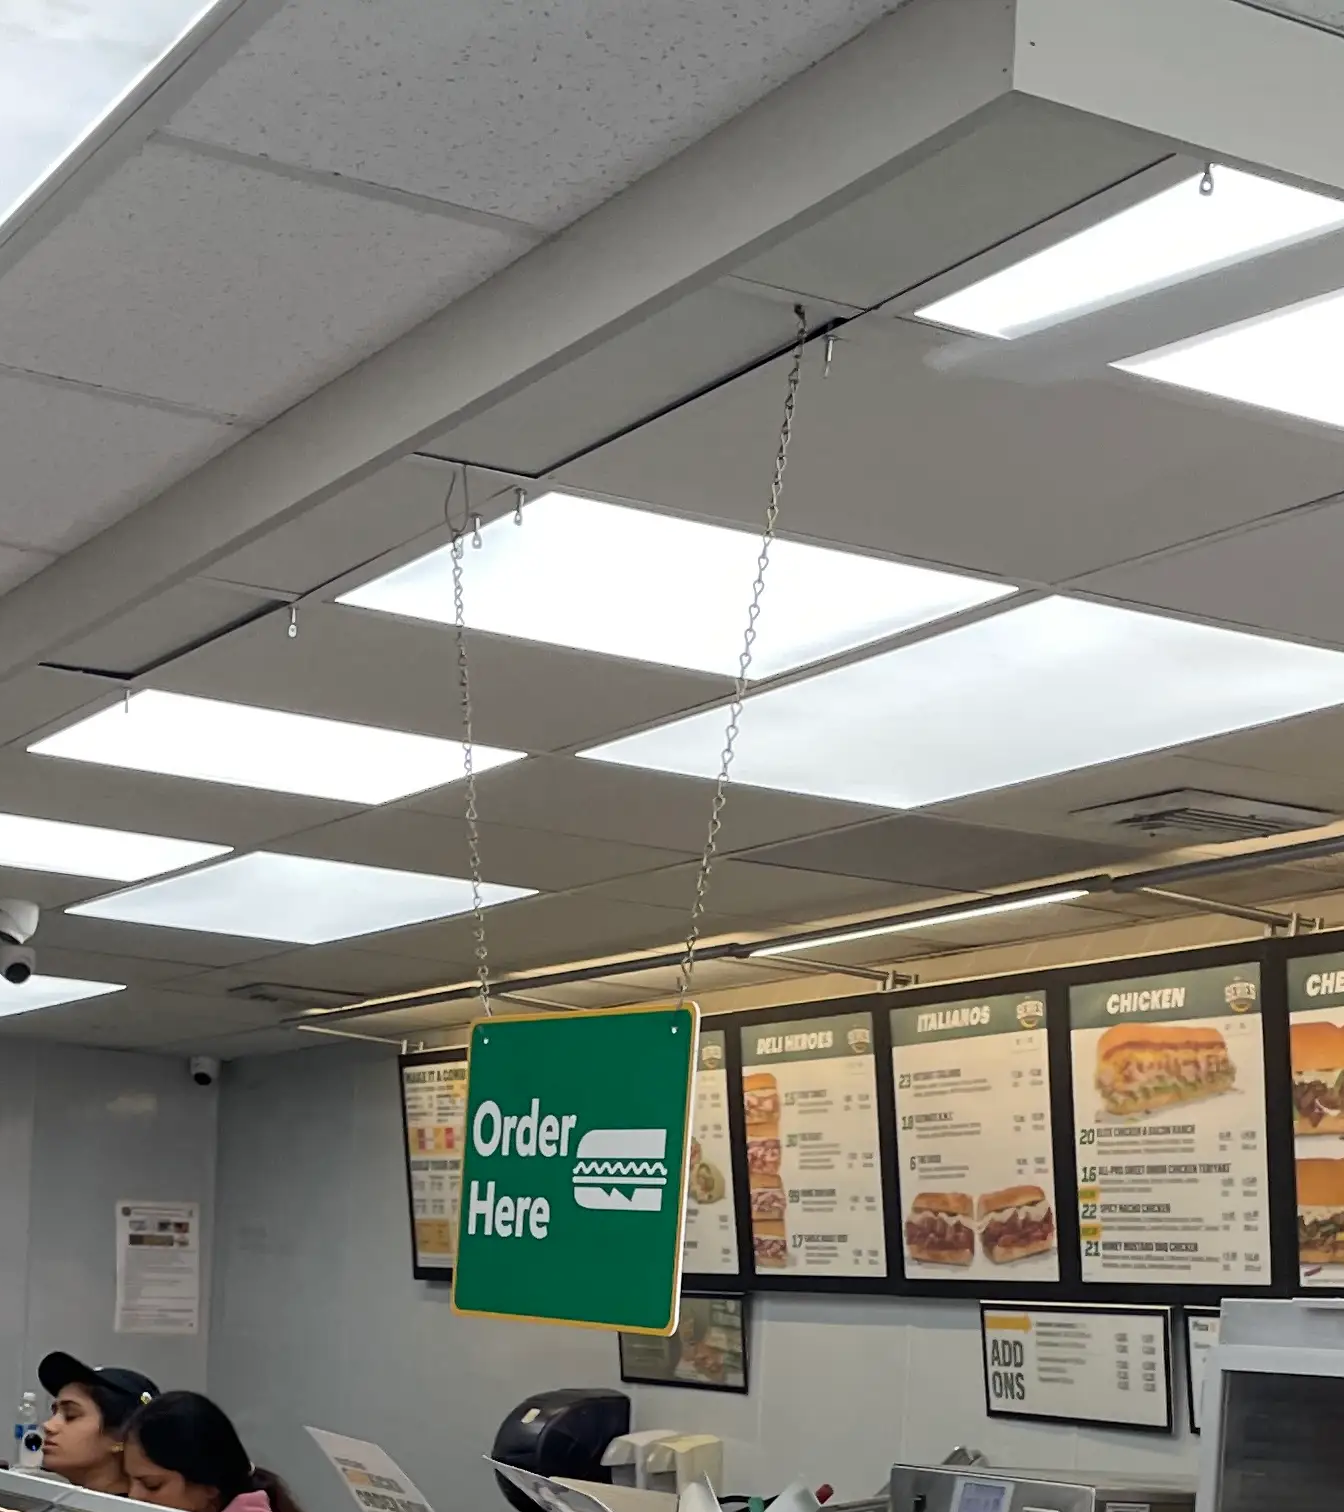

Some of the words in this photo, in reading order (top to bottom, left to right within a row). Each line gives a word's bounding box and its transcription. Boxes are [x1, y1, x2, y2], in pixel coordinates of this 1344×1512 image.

[1105, 988, 1186, 1015] CHICKEN
[916, 1006, 990, 1033] ITALIANOS
[472, 1097, 577, 1158] Order
[1079, 1129, 1095, 1145] 20
[909, 1157, 917, 1171] 6
[1081, 1166, 1096, 1182] 16
[466, 1180, 551, 1240] Here
[1081, 1204, 1097, 1219] 22
[1084, 1241, 1100, 1257] 21
[991, 1338, 1025, 1368] ADD
[992, 1371, 1026, 1400] ONS
